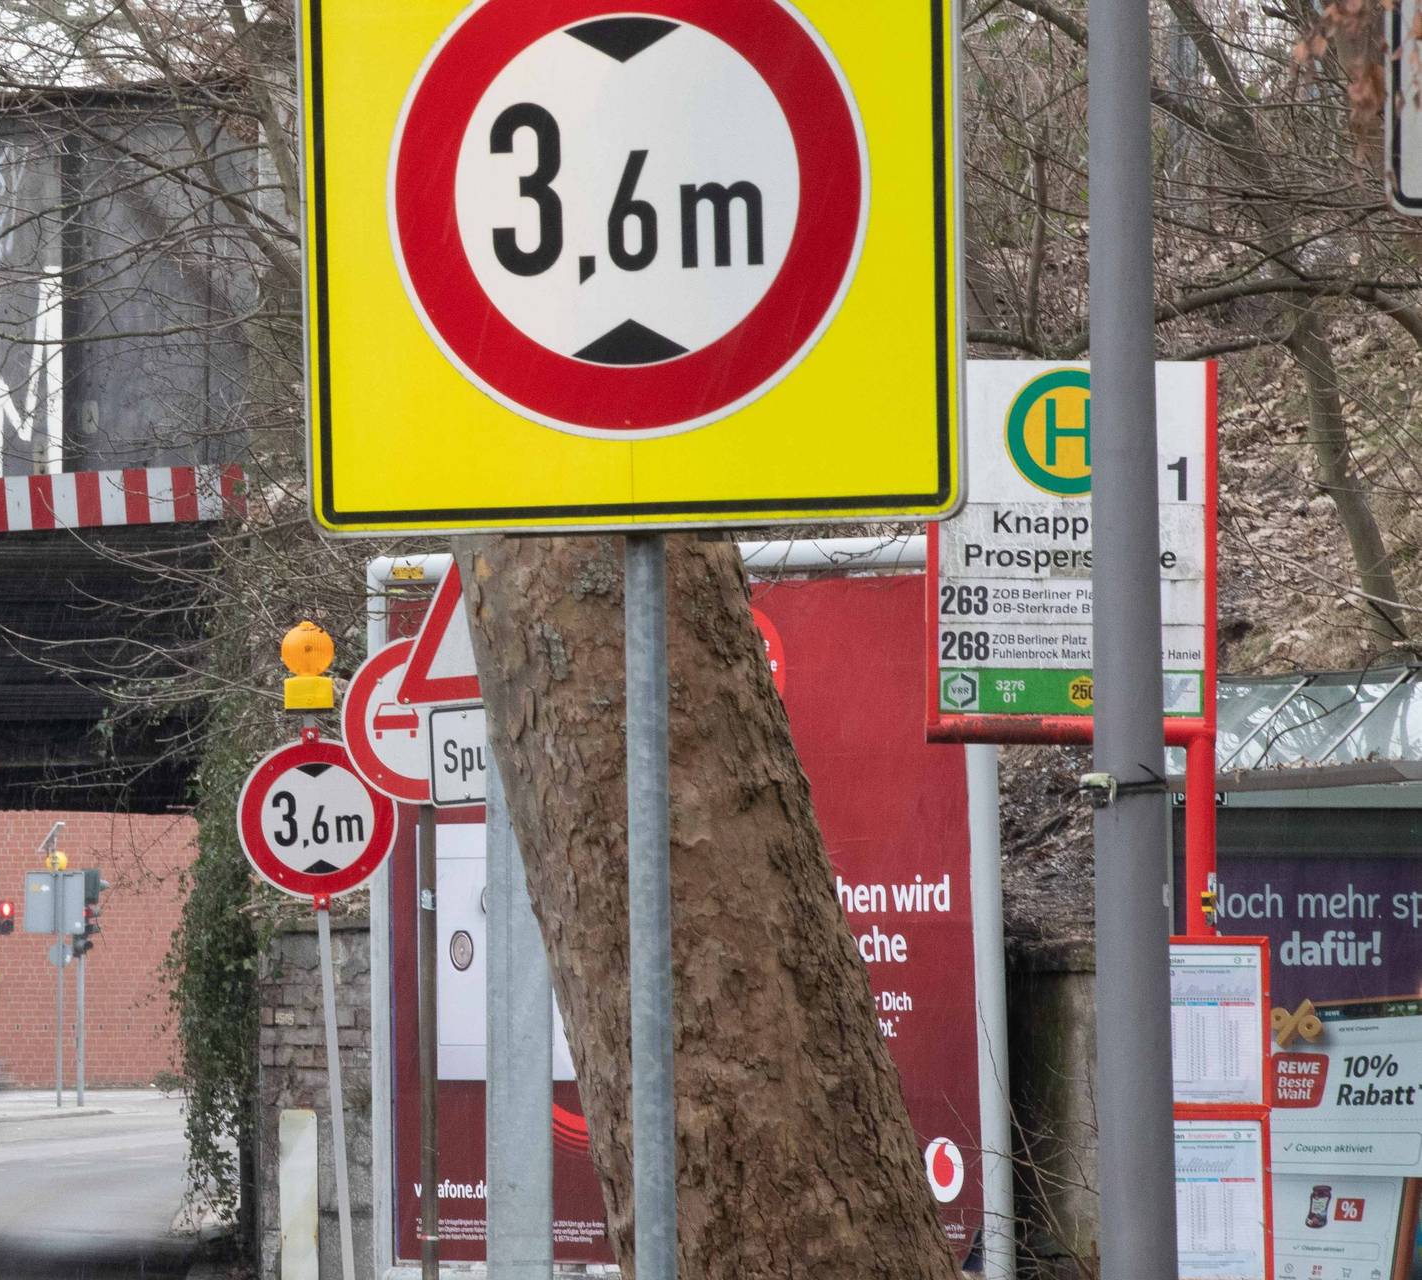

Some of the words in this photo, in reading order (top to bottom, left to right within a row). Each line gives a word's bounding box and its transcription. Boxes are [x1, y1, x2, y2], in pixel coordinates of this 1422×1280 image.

[1167, 456, 1188, 502] 1
[993, 510, 1089, 540] Knapp
[964, 544, 1177, 573] Prosperse
[941, 586, 989, 616] 263
[993, 590, 1019, 600] ZOB
[1022, 589, 1071, 600] Berliner
[1076, 589, 1095, 600] Pla
[993, 604, 1078, 614] OB-Sterkrade
[1082, 604, 1093, 614] B
[941, 631, 990, 661] 268
[993, 635, 1015, 645] ZOB
[1018, 634, 1058, 645] Berliner
[1062, 635, 1087, 646] Platz
[993, 650, 1058, 660] Fuhlenbrock
[1062, 650, 1091, 660] Markt
[1168, 650, 1201, 660] Haniel
[995, 680, 1026, 691] 3276
[1003, 693, 1017, 703] 01
[443, 739, 486, 782] Spu
[836, 874, 887, 913] hen
[891, 874, 951, 912] wird
[854, 925, 908, 963] che
[1280, 929, 1383, 967] dafür!
[882, 990, 913, 1011] Dich
[1277, 1061, 1321, 1075] REWE
[1344, 1053, 1398, 1078] 10%
[1278, 1077, 1315, 1088] Beste
[1277, 1087, 1311, 1100] Wahl
[1295, 1143, 1332, 1154] Coupon
[1334, 1144, 1374, 1153] aktiviert
[414, 1178, 488, 1199] vafone.d
